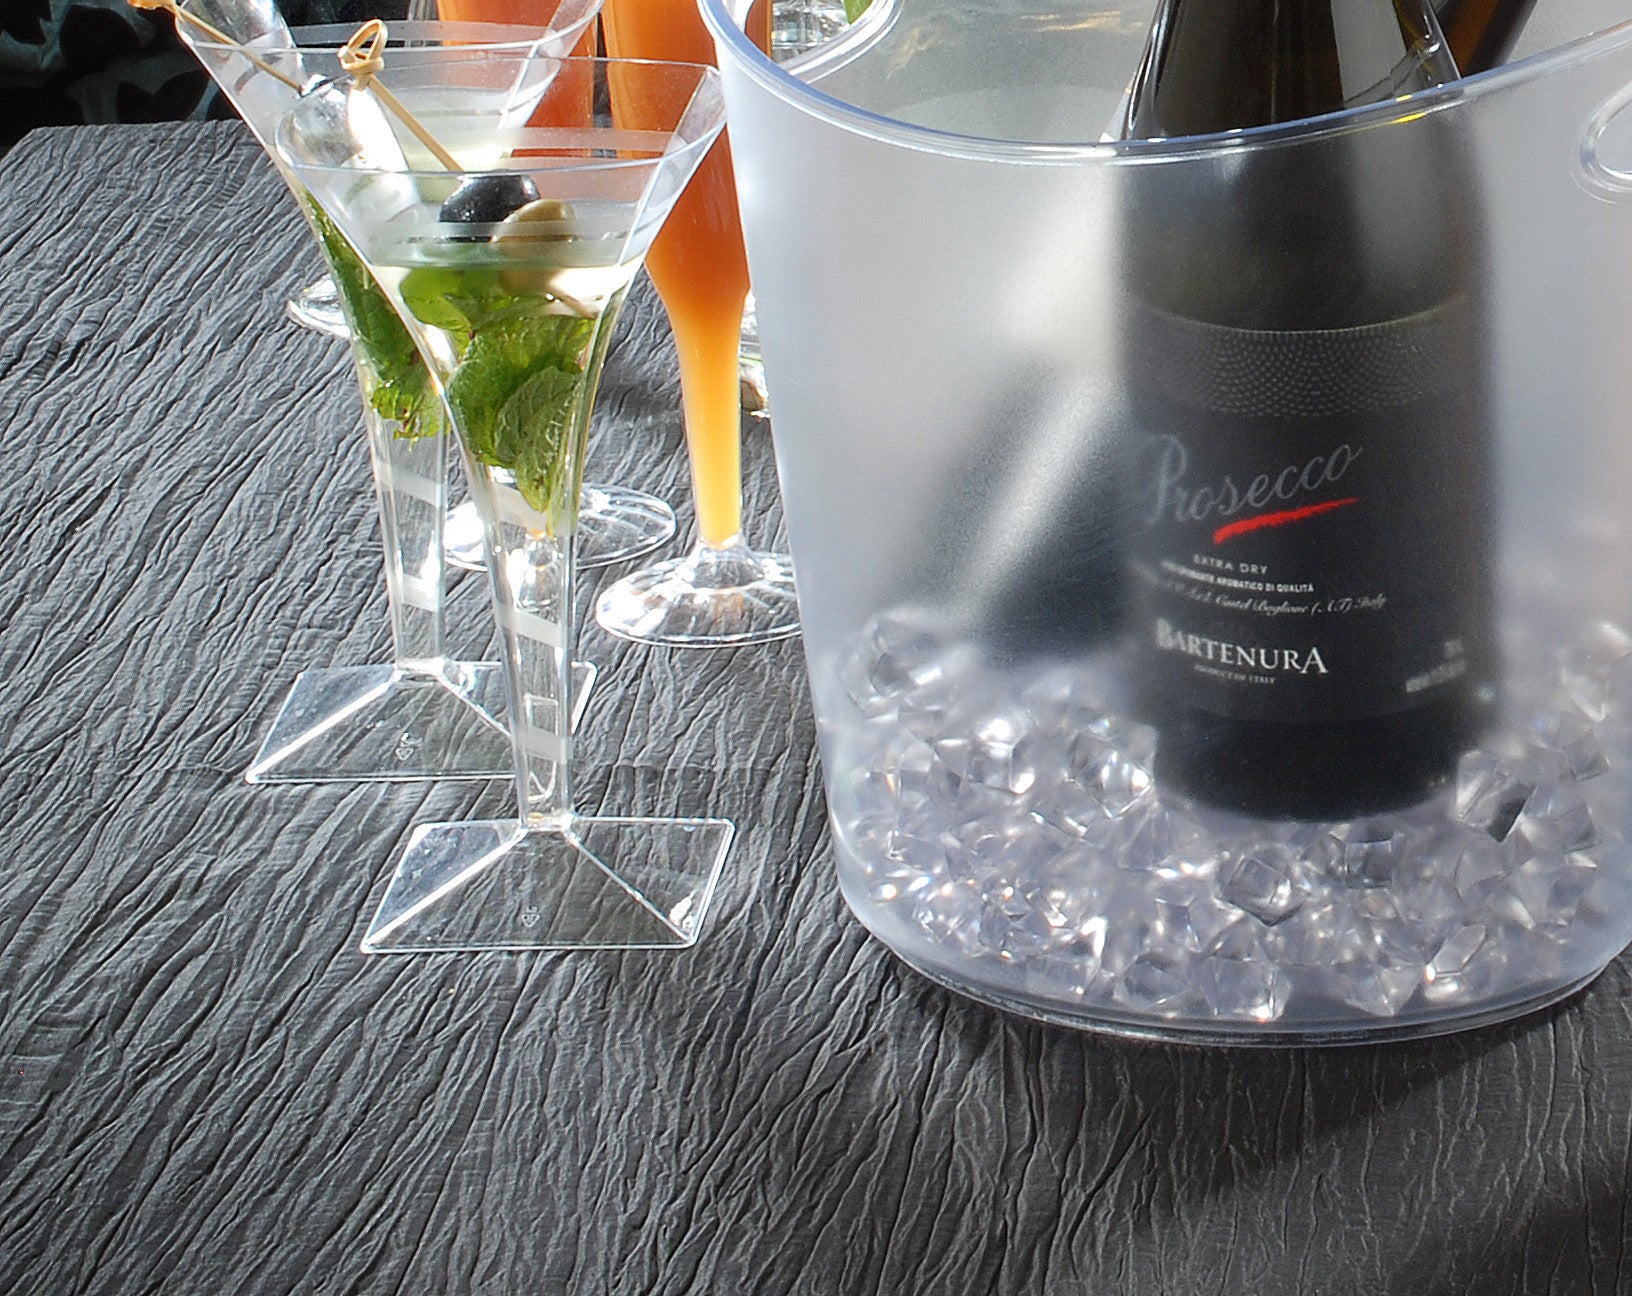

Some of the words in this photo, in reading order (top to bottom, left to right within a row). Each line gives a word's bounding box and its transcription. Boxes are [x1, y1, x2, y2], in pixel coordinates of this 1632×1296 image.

[1142, 433, 1363, 526] Prosecco
[1192, 552, 1234, 571] EXTRA
[1239, 562, 1268, 575] DRY
[1156, 617, 1329, 674] BARTENURA
